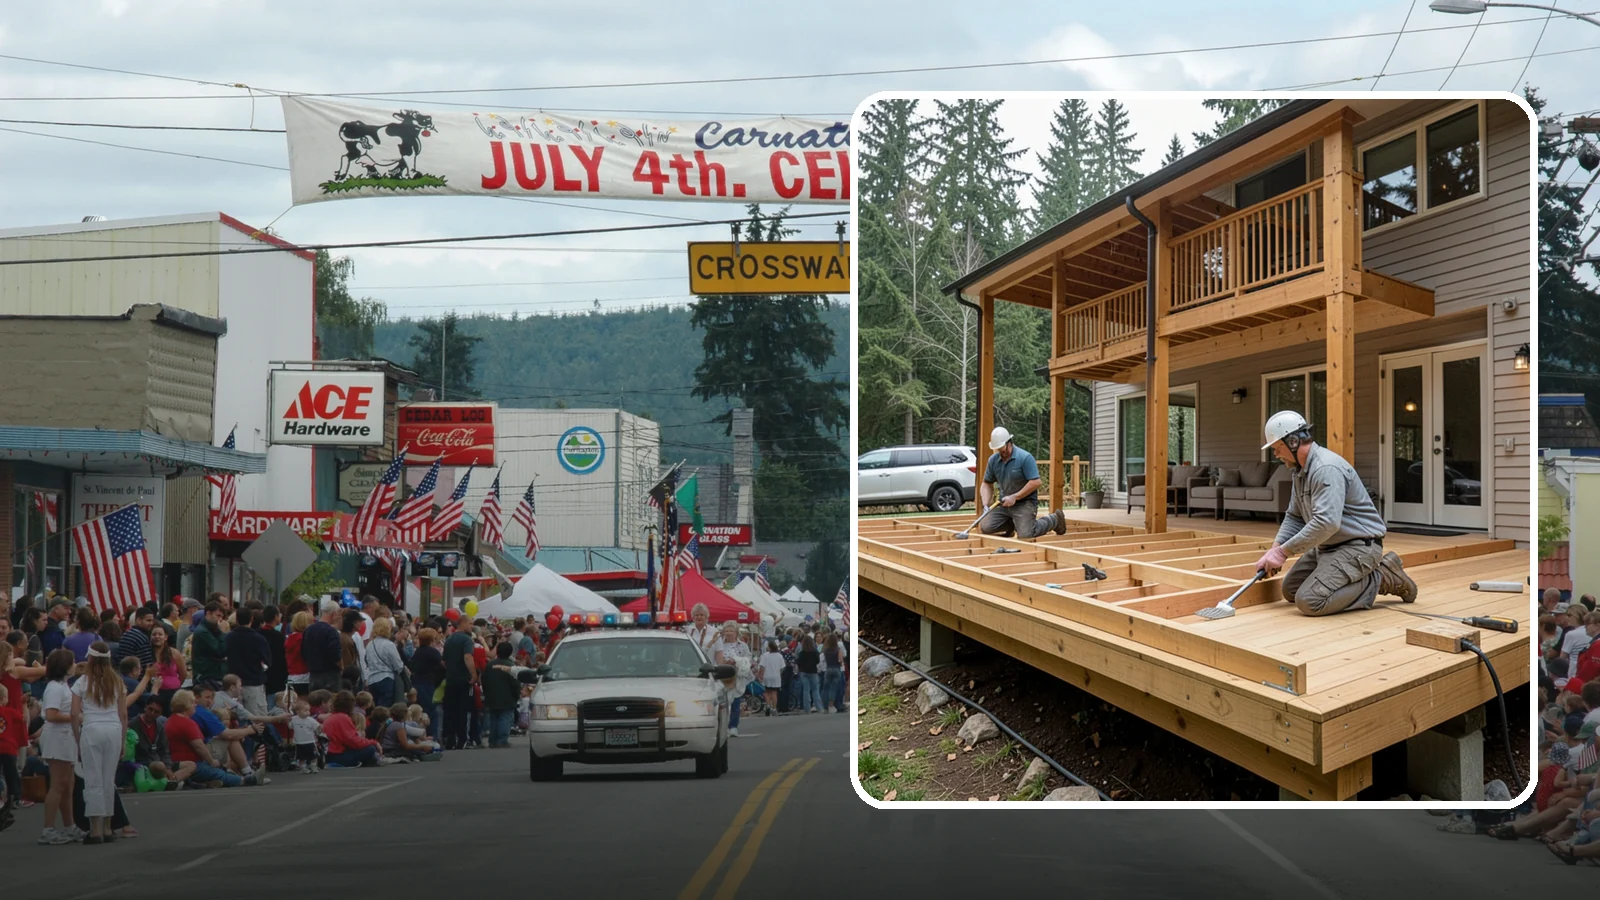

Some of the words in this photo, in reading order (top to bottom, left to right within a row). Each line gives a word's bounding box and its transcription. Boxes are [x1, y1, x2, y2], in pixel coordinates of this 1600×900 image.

[695, 121, 850, 150] Carnat
[481, 141, 605, 193] JULY
[632, 150, 747, 198] 4th.
[697, 253, 850, 280] CROSSWA
[283, 380, 373, 420] ACE
[405, 409, 452, 422] CEDAR
[461, 409, 485, 421] LOG
[283, 421, 371, 436] Hardware
[416, 428, 477, 447] Coca-Cola
[353, 467, 386, 479] Simpl
[96, 485, 124, 494] Vincent
[126, 486, 136, 494] de
[138, 486, 155, 495] Paul
[81, 503, 154, 522] THT
[212, 516, 331, 535] HARDARE
[688, 526, 742, 535] CRNATION
[699, 535, 730, 543] GLASS
